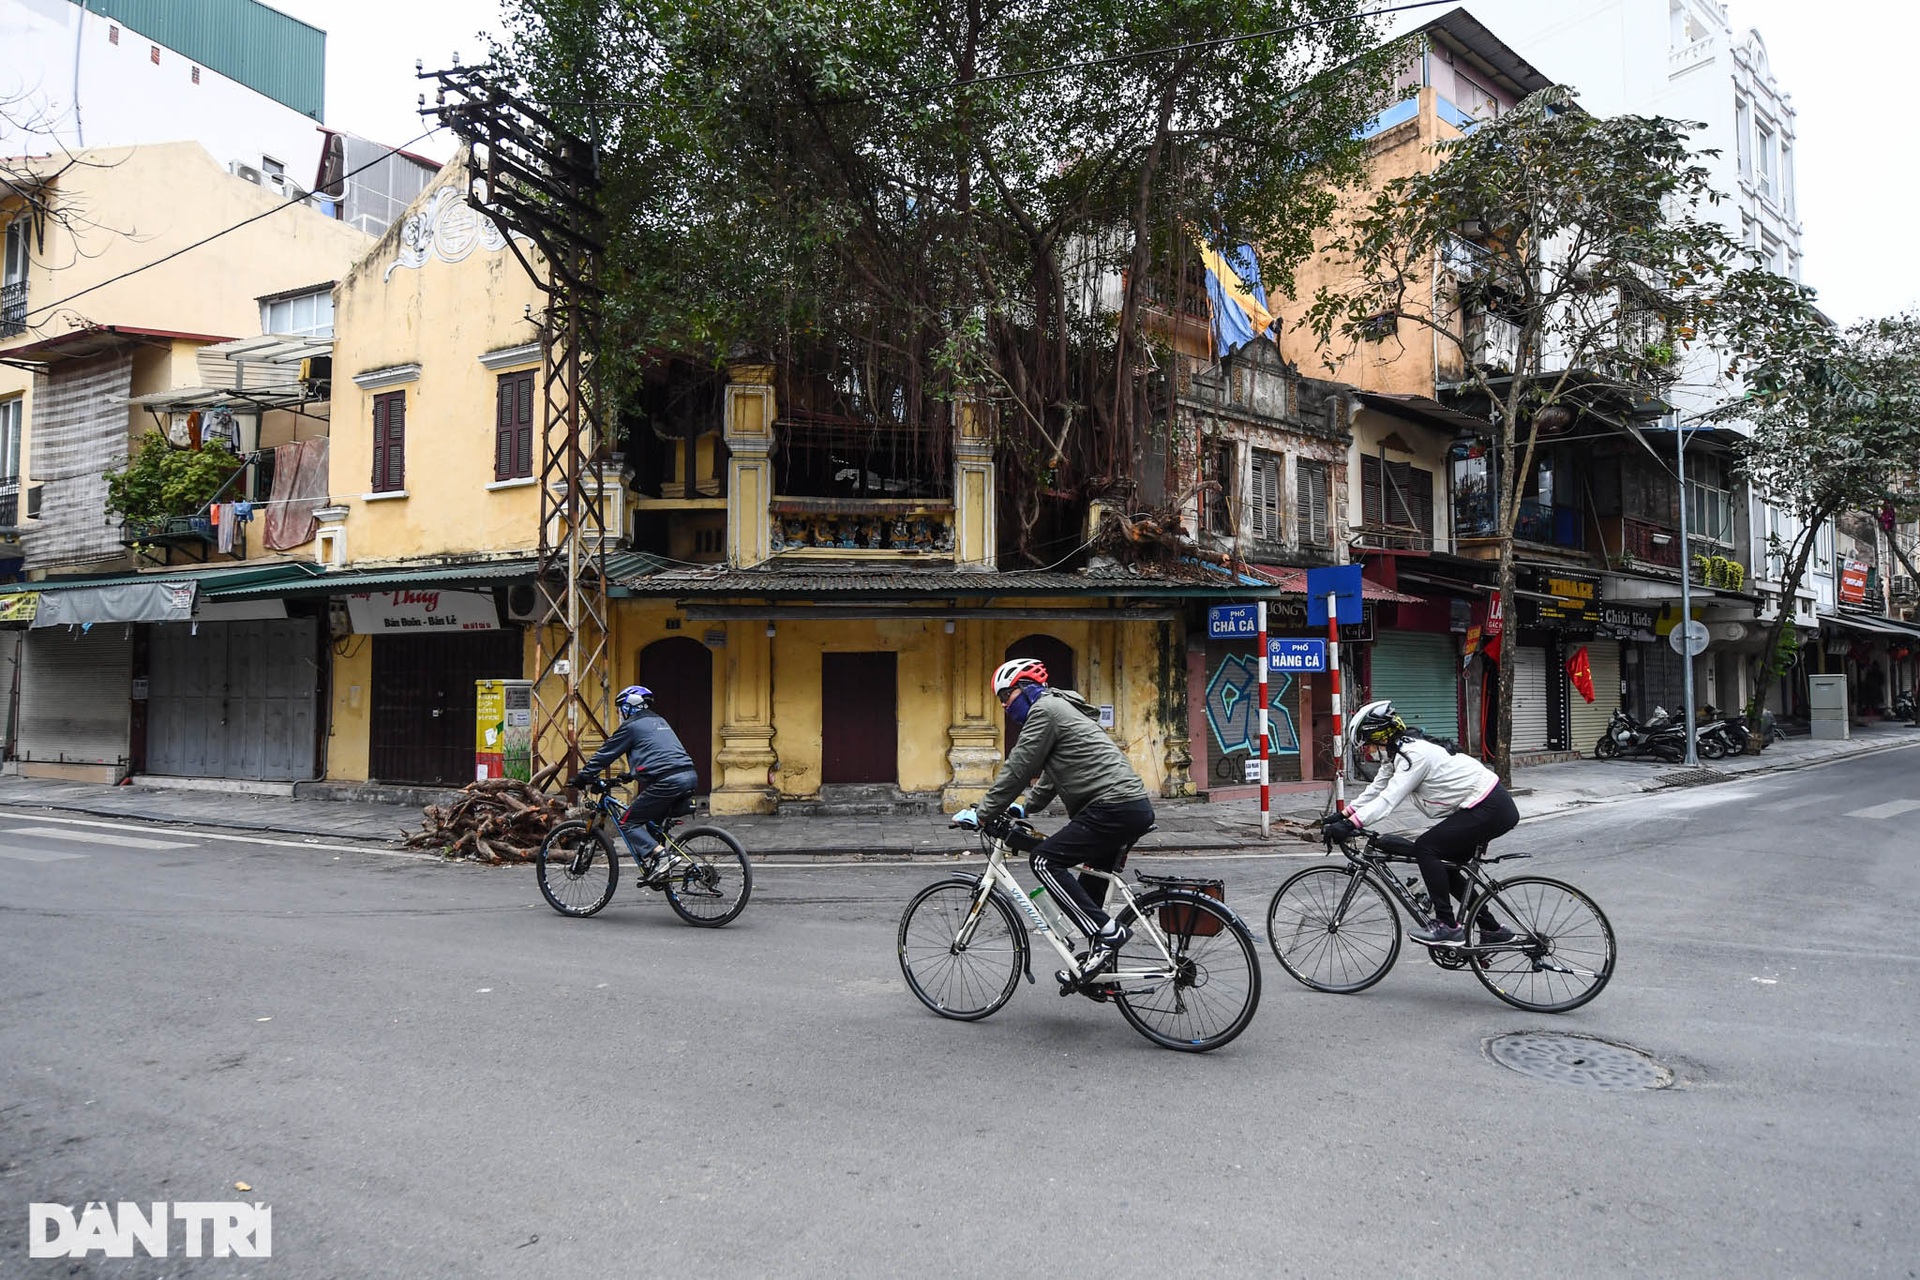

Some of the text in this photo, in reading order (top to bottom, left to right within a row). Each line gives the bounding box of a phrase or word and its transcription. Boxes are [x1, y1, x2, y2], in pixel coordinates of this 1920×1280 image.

[1213, 617, 1255, 632] CHẢ CÁ
[1605, 609, 1630, 625] Chibi
[1632, 612, 1652, 627] Kids
[1292, 642, 1309, 651] PHỐ
[1272, 653, 1320, 667] HÀNG CÁ
[1379, 862, 1430, 928] ORBE
[1010, 887, 1050, 932] SPECIALIZED
